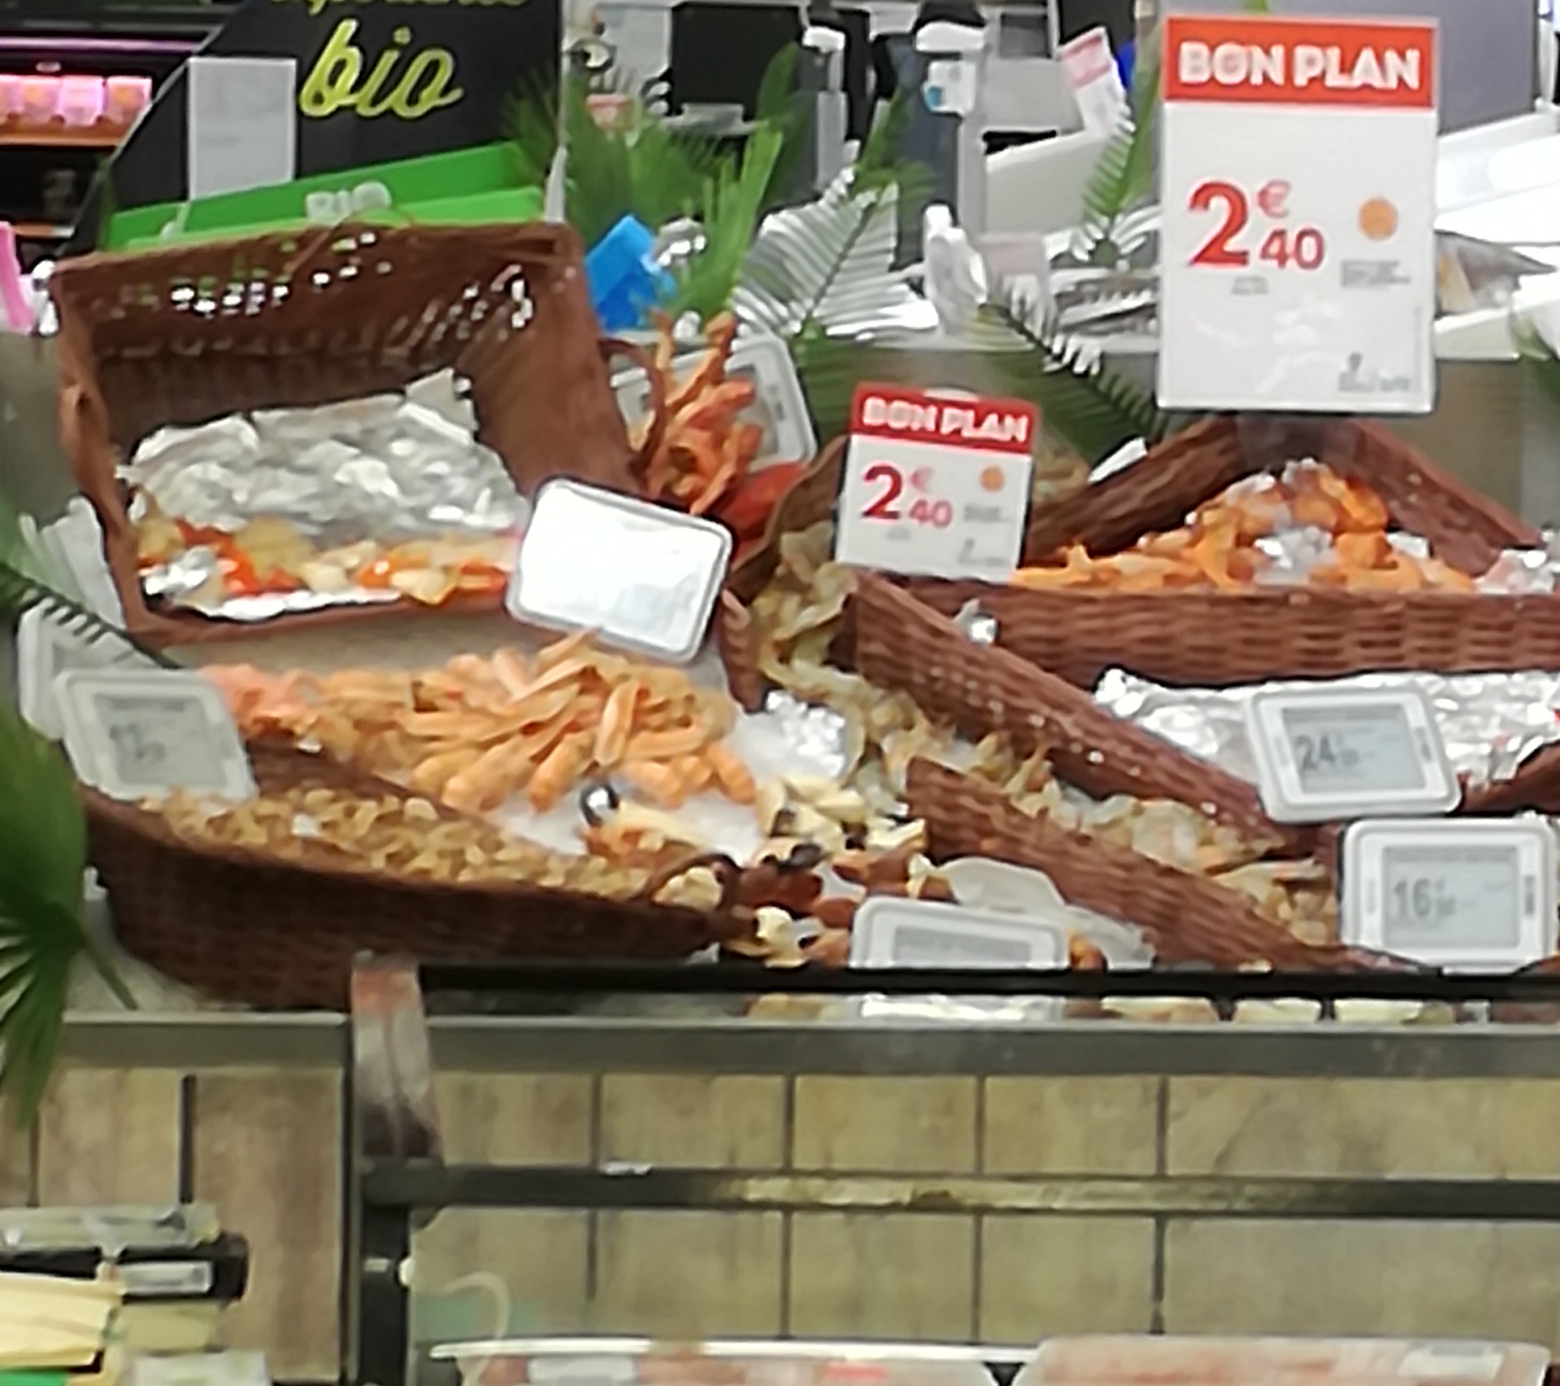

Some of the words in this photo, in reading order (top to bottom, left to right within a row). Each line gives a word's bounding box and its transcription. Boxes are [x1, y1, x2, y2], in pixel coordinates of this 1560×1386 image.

[300, 19, 464, 117] bio
[1179, 42, 1285, 86] BON
[1293, 46, 1421, 90] PLAN
[862, 397, 938, 431] BON
[940, 407, 1028, 442] PLAN
